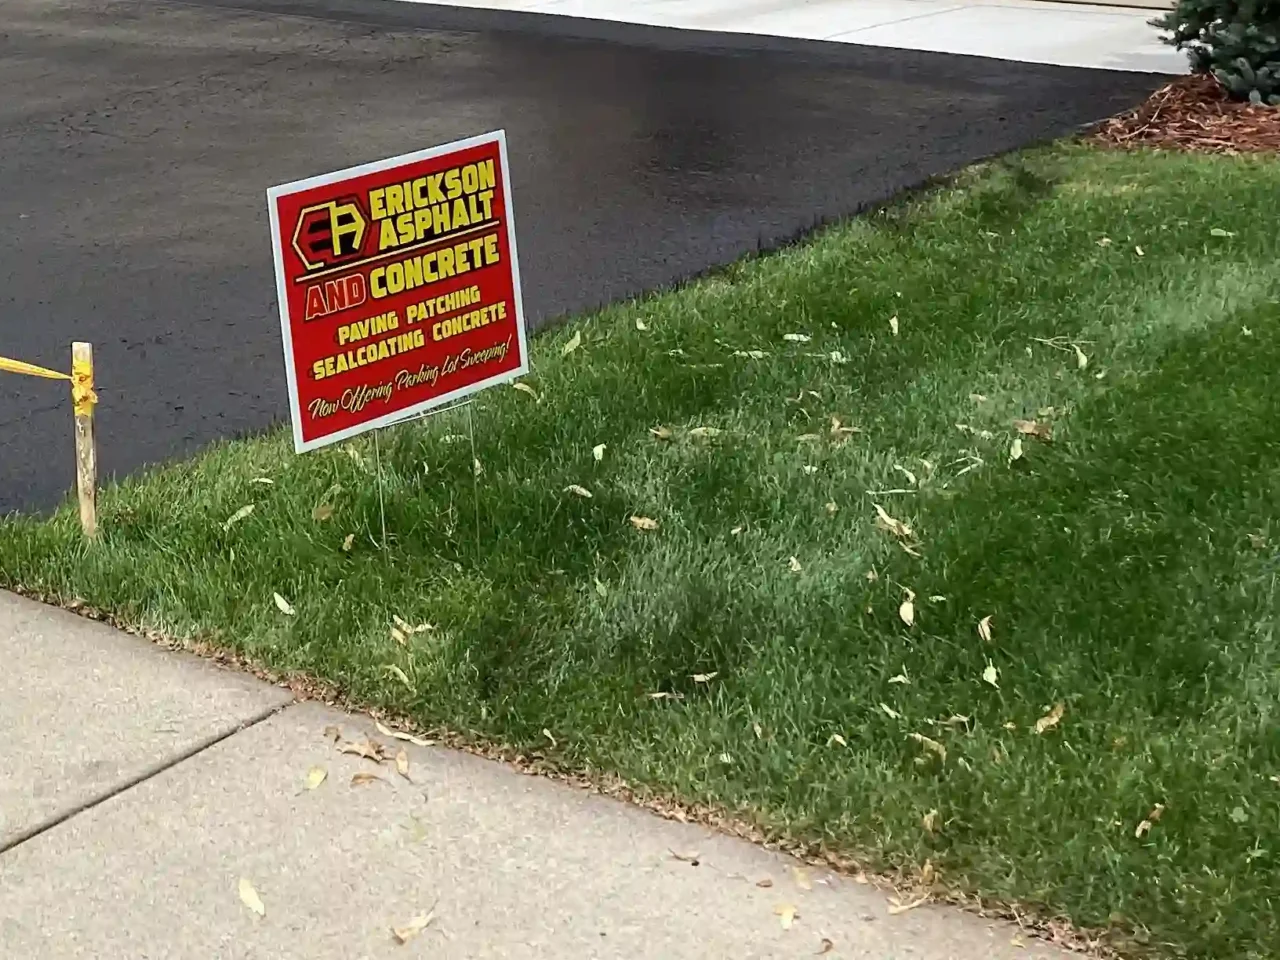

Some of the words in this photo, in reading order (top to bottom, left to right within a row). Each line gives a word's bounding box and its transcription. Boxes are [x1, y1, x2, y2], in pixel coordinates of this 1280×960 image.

[369, 159, 496, 221] ERICKSON
[378, 189, 494, 251] ASPHALT
[305, 272, 367, 321] AND
[369, 233, 500, 300] CONCRETE
[312, 328, 425, 381] SEALCOATING
[432, 301, 507, 342] CONCRETE
[337, 310, 399, 346] PAVING
[405, 285, 481, 325] PATCHING
[307, 397, 340, 420] Now
[340, 380, 394, 414] Offering
[394, 363, 439, 391] Parking
[440, 355, 459, 378] Lot
[459, 333, 513, 369] Sweeping!
